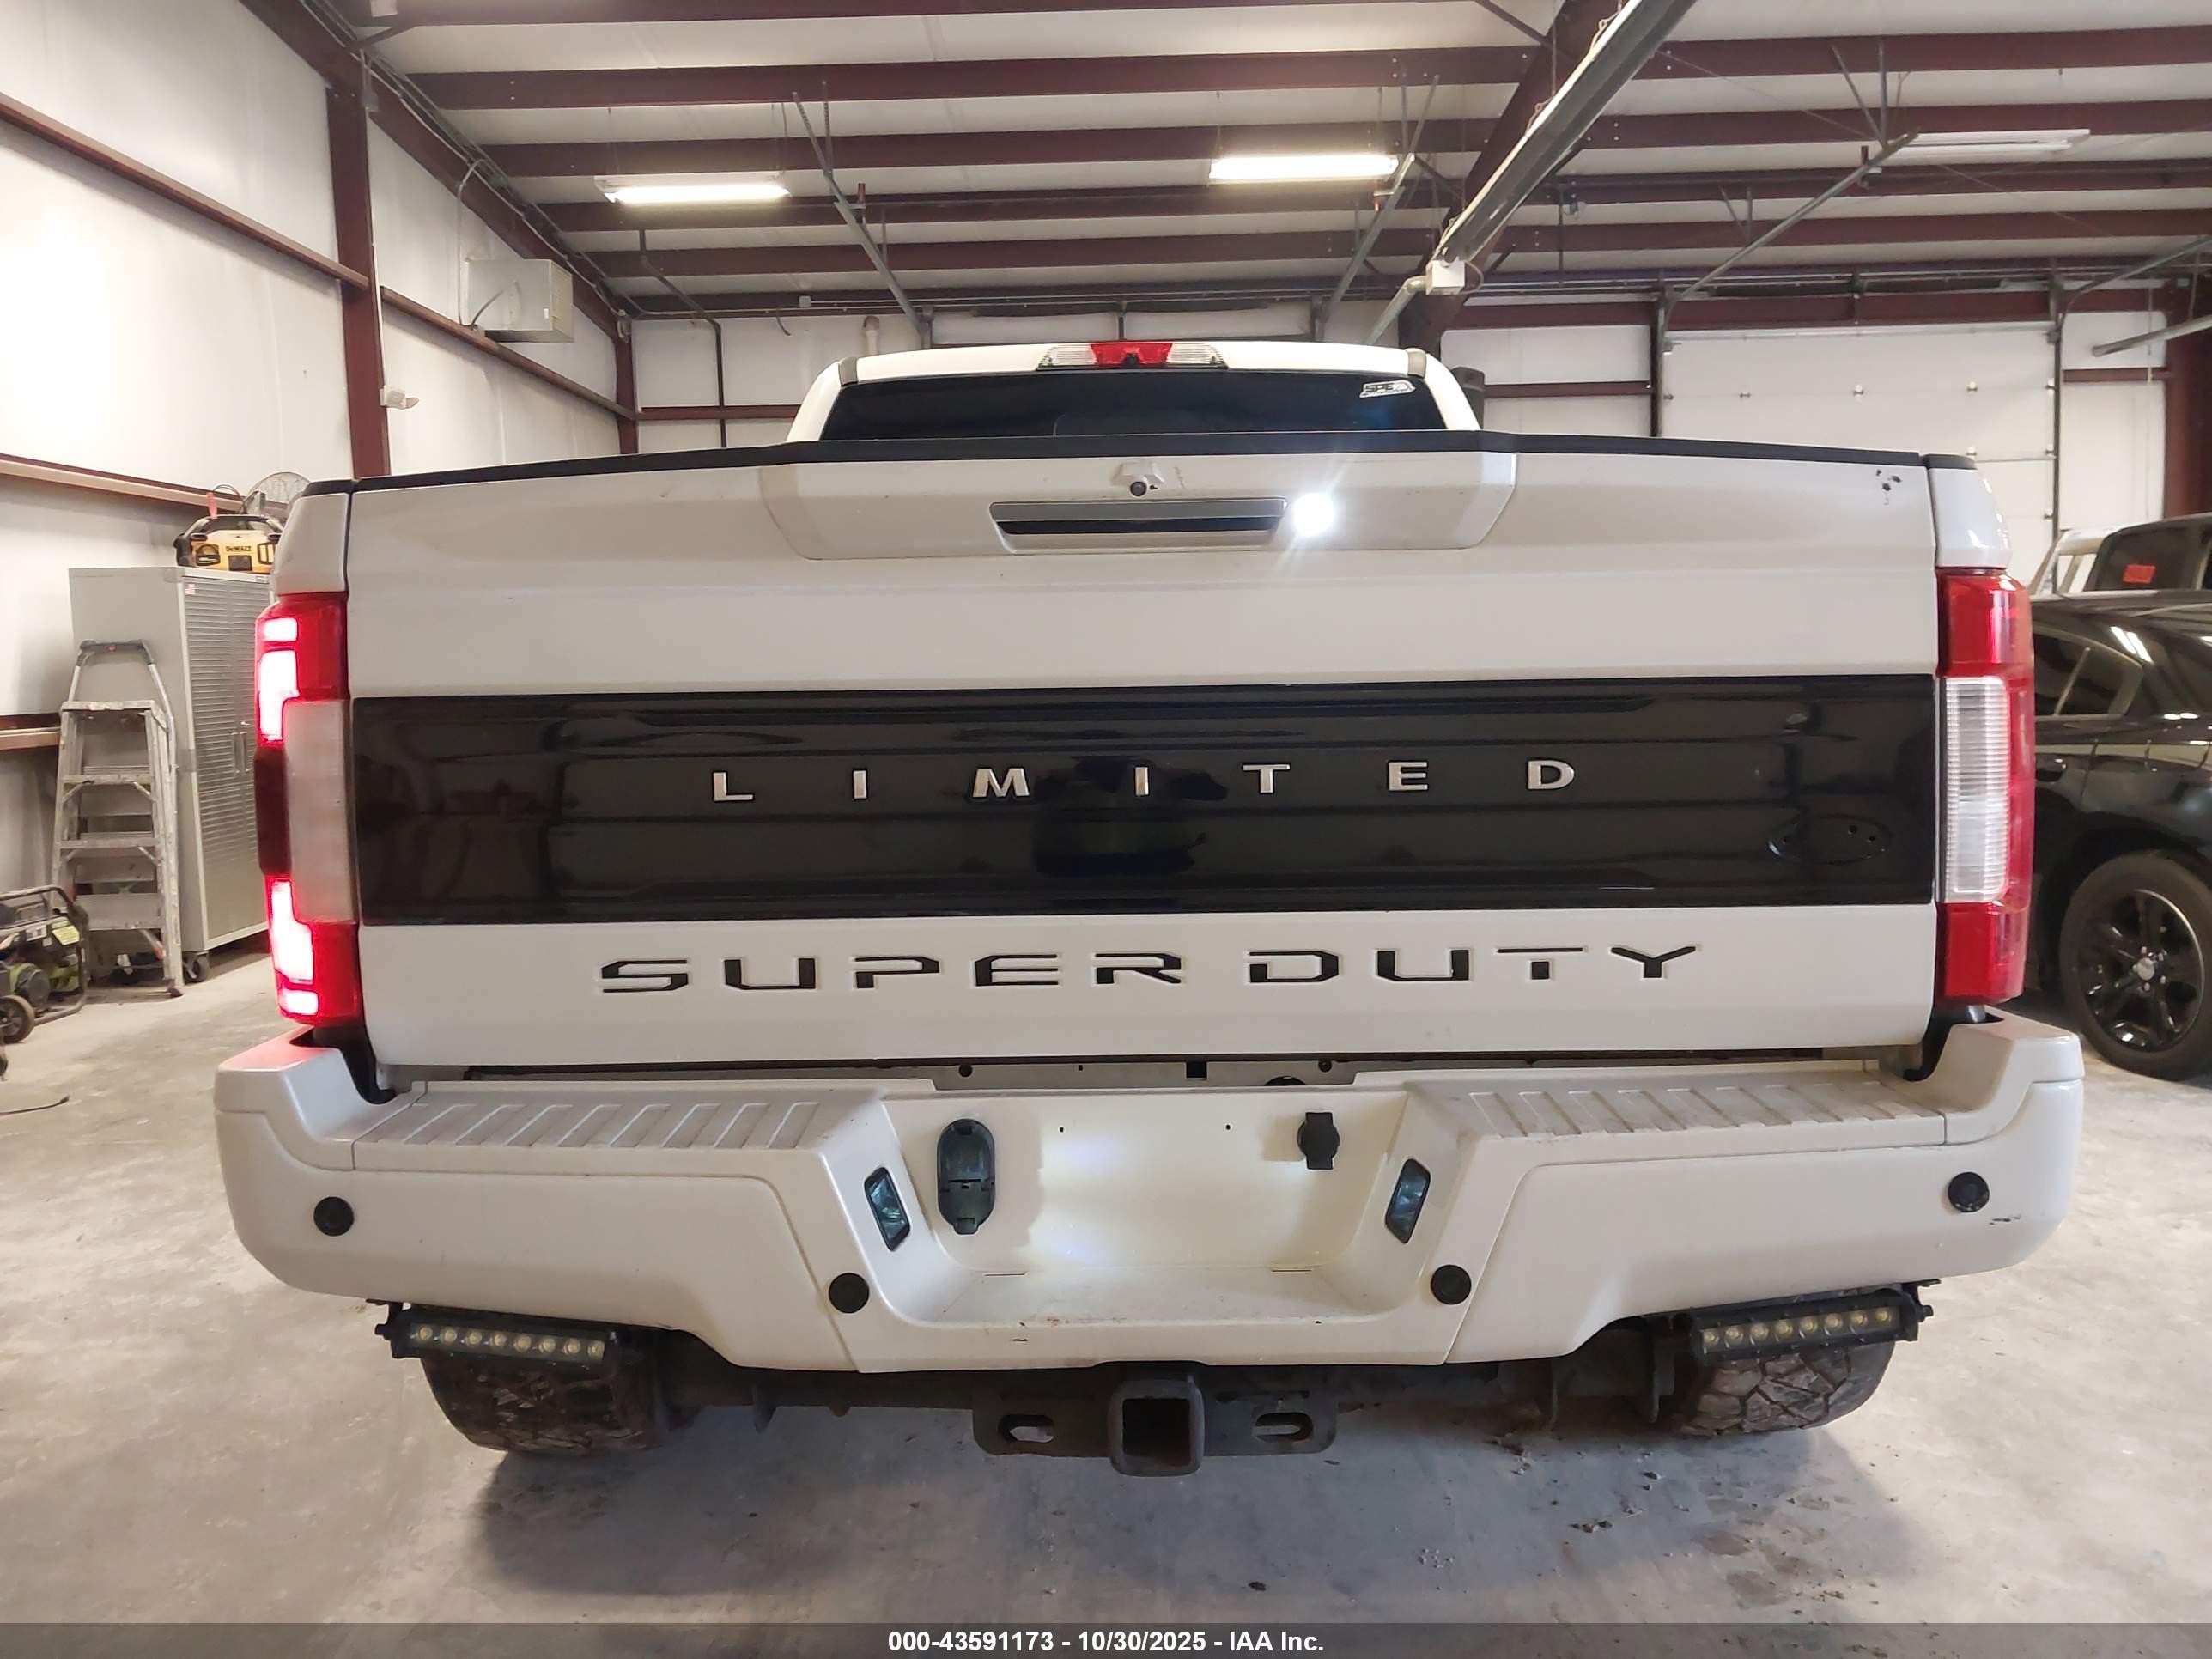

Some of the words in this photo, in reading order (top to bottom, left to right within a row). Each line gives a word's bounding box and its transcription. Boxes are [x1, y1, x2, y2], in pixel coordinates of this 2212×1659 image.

[713, 761, 1575, 800] LIMITED
[600, 952, 1182, 994] SUPER
[1249, 945, 1697, 984] DUTY
